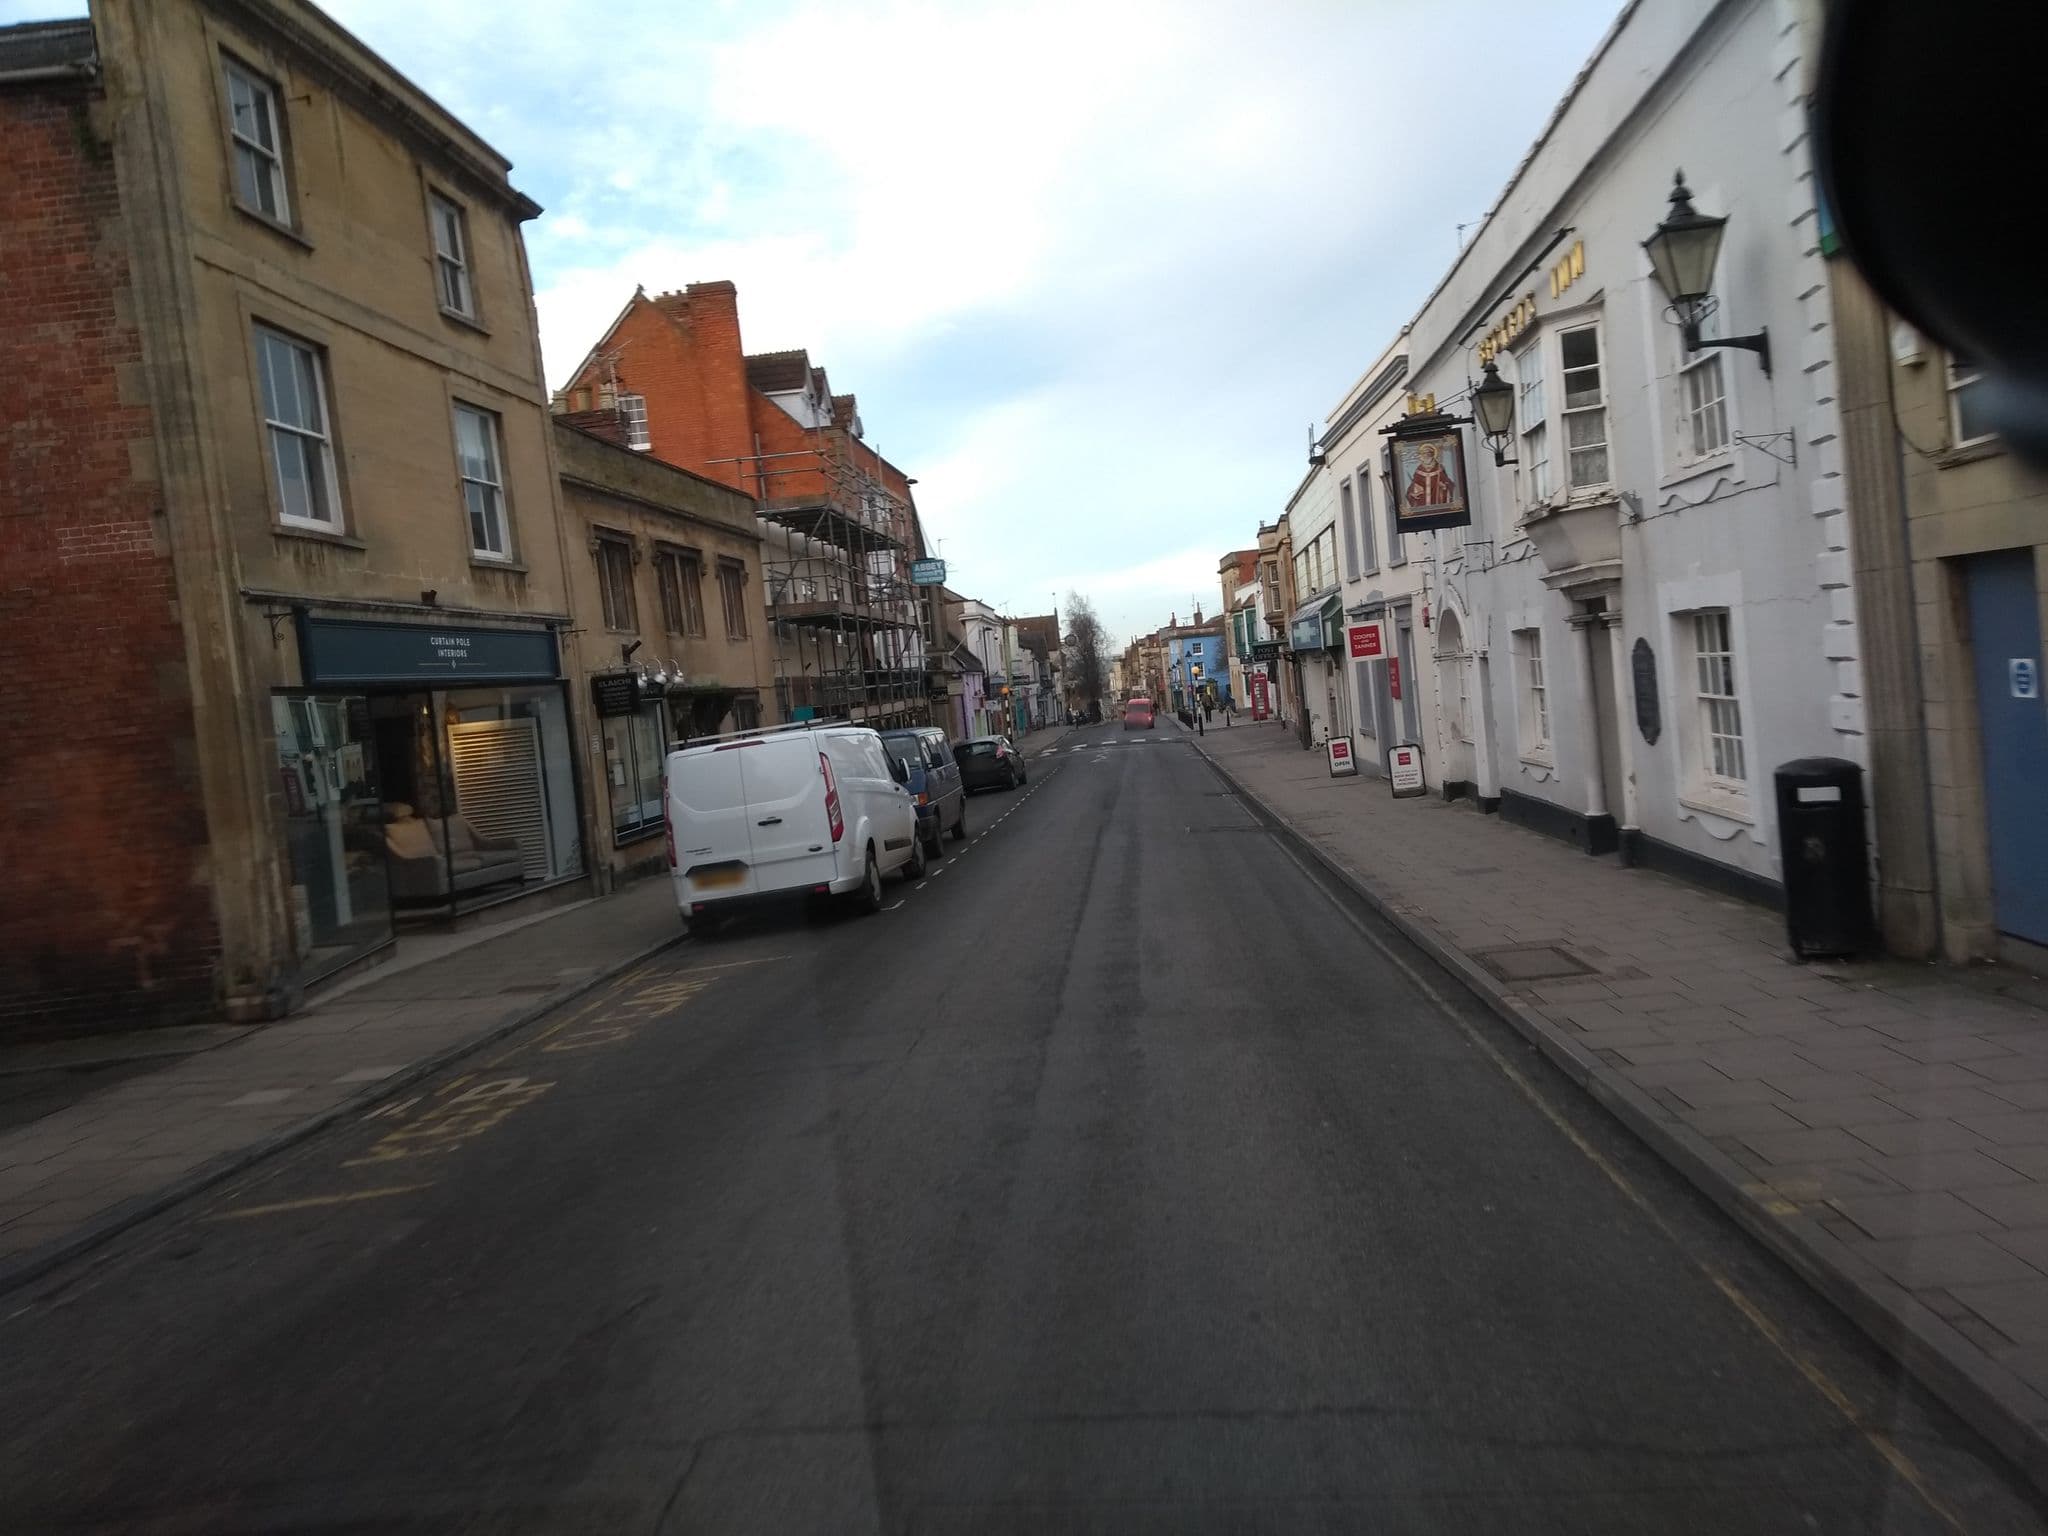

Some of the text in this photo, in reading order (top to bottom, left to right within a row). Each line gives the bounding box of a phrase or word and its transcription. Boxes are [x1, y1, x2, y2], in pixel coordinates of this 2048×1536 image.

[1550, 239, 1585, 299] INN
[915, 561, 943, 571] ABBEY
[1353, 632, 1376, 641] COOPER
[431, 637, 470, 646] CURTAIN POLE
[1354, 642, 1377, 650] TANNER
[438, 649, 467, 657] INTERIORS
[1254, 652, 1280, 660] OFFICE
